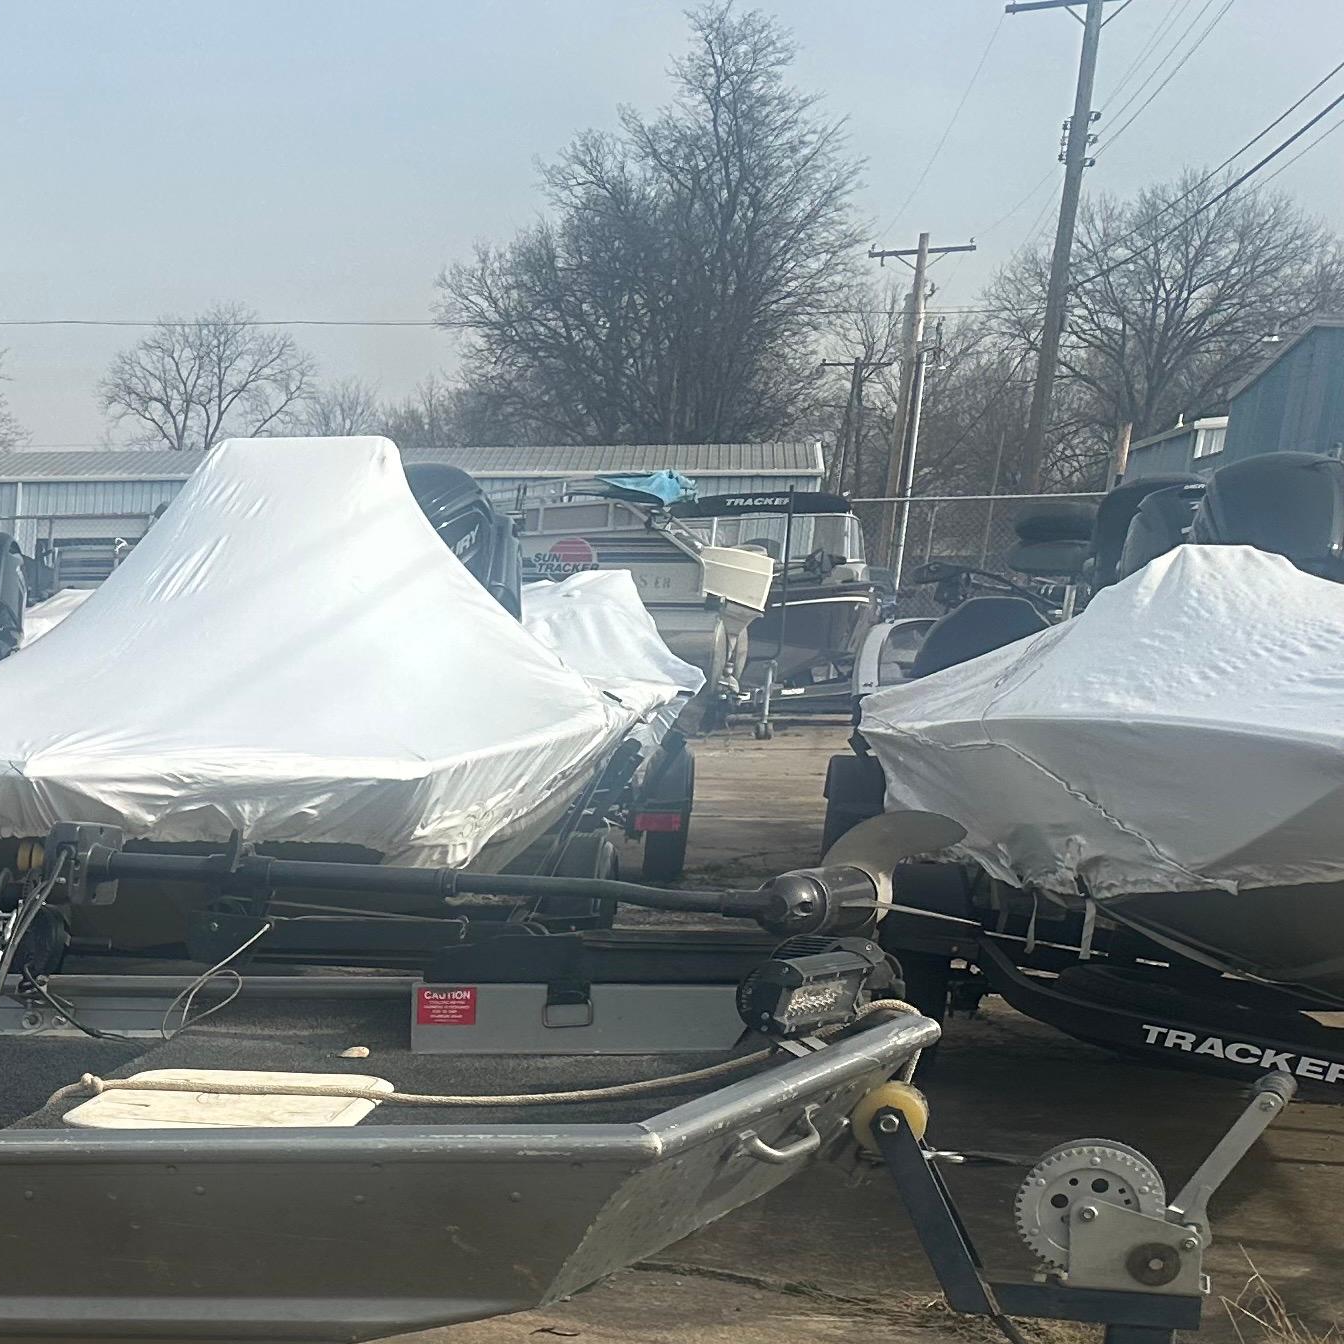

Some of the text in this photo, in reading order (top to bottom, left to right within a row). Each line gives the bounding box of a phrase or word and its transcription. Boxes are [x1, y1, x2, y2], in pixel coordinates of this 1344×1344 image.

[533, 553, 561, 563] SUN
[538, 562, 599, 573] TRACKER
[424, 990, 471, 1000] CAUTION
